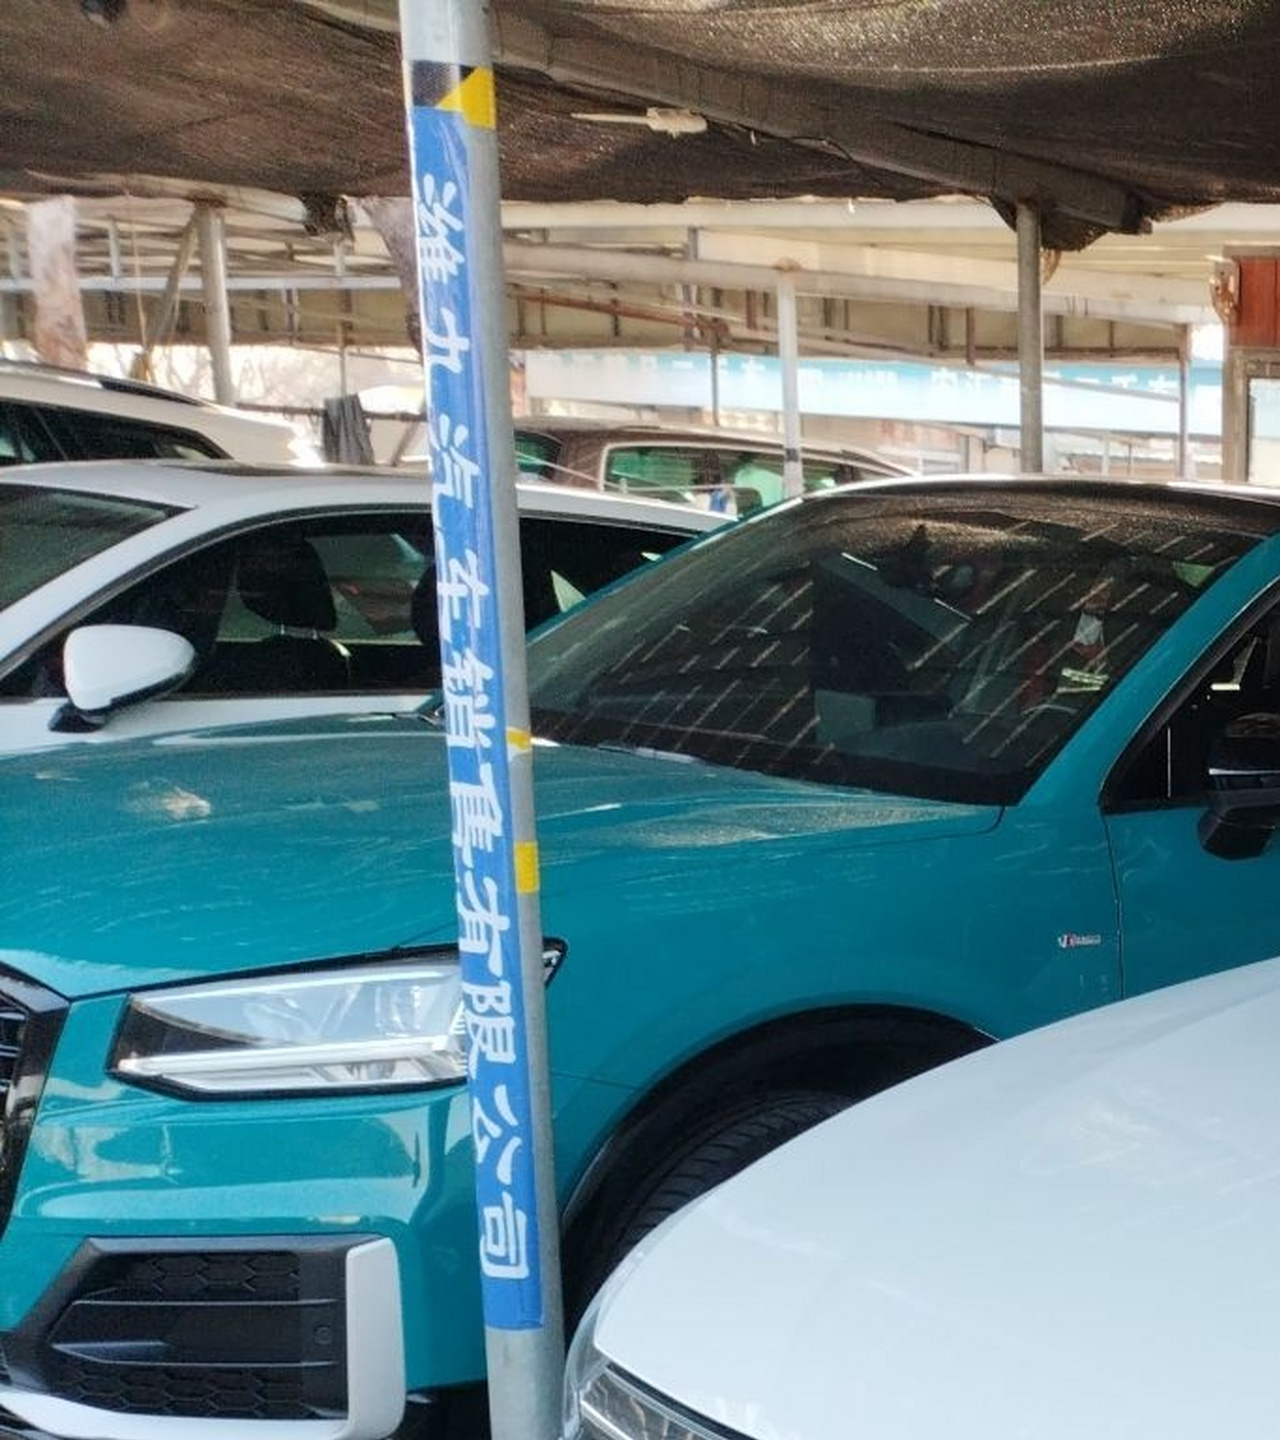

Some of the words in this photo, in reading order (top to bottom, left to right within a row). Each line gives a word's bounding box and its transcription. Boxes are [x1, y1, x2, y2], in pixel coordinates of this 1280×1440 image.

[419, 173, 530, 1280] 潍九汽车销售有限公司
